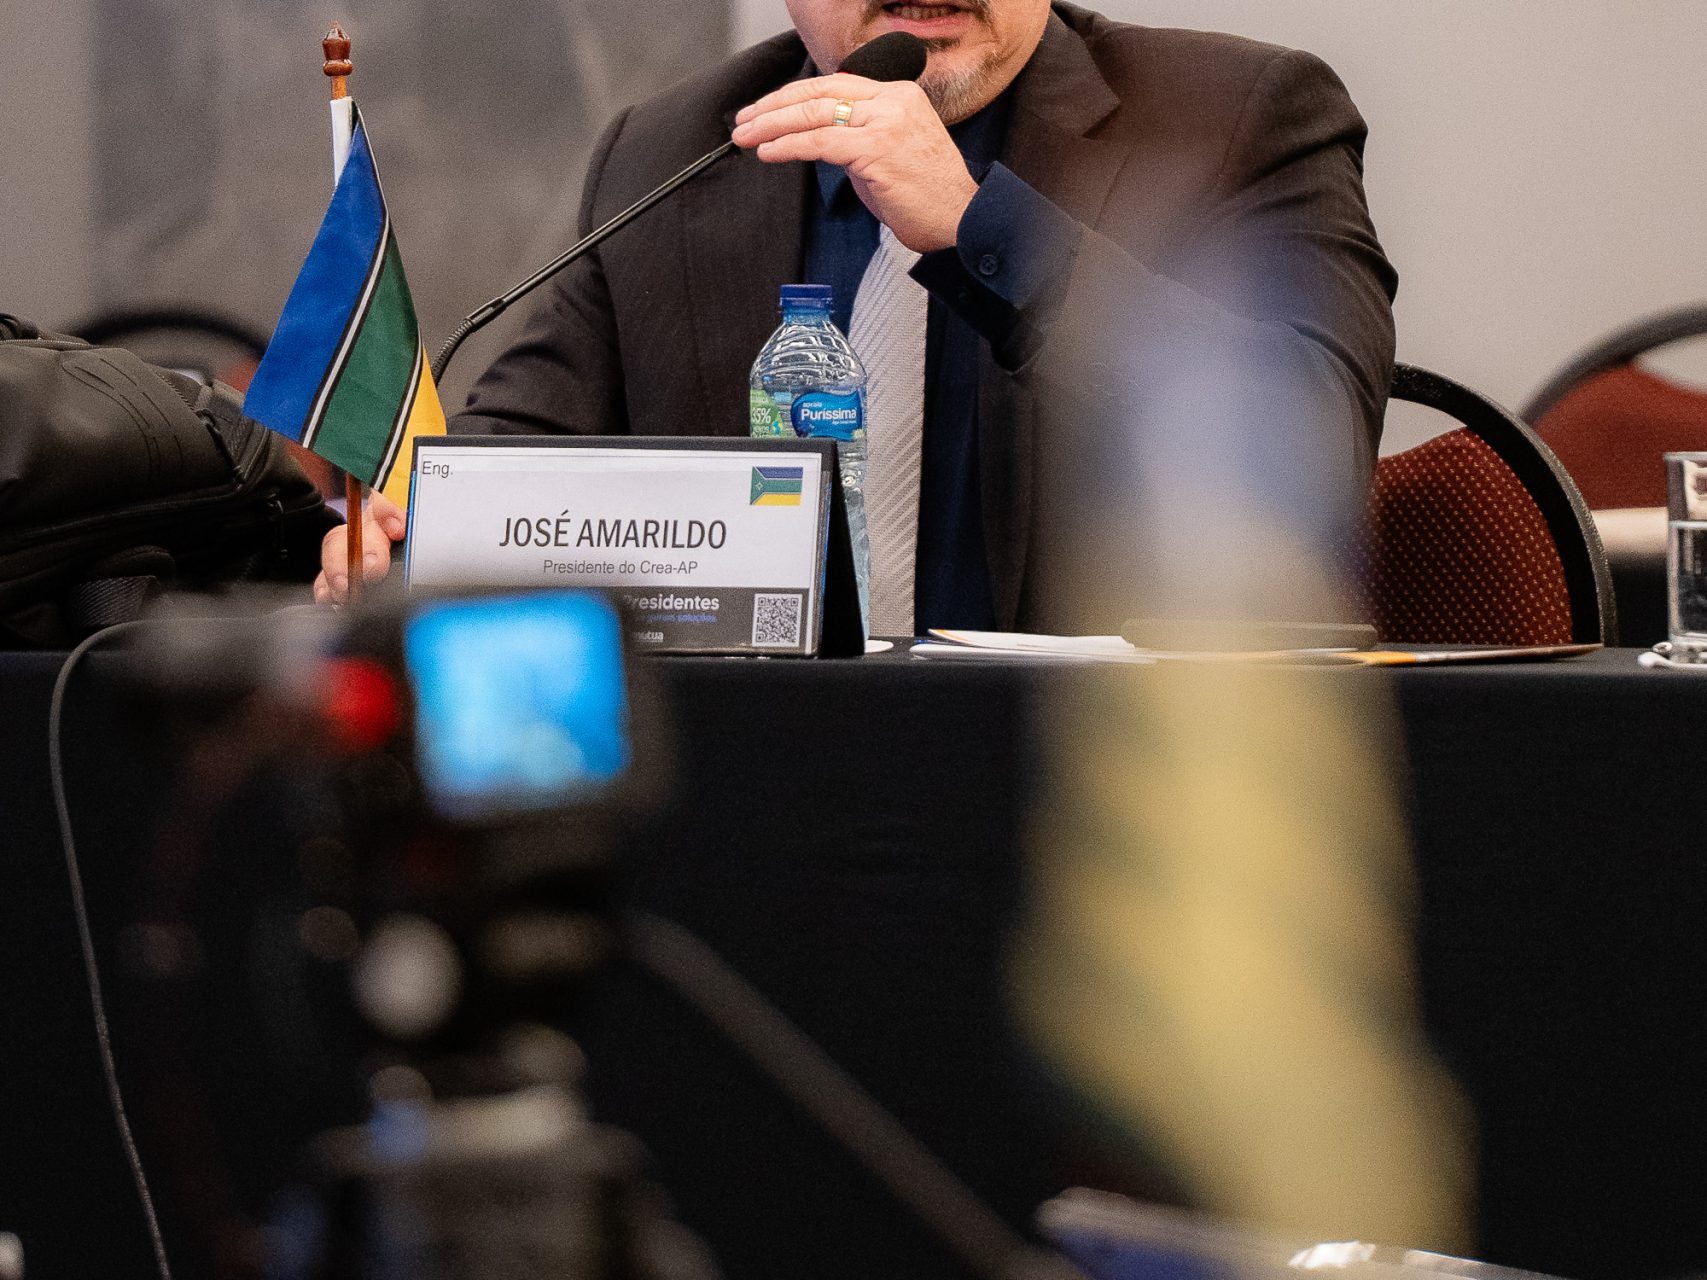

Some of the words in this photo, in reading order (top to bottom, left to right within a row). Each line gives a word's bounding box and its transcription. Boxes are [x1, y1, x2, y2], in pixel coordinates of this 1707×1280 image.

[422, 460, 453, 479] Eng.
[499, 508, 571, 548] JOSÉ
[576, 518, 728, 550] AMARILDO
[543, 559, 614, 574] Presidente
[619, 560, 635, 574] do
[640, 560, 698, 574] Crea-AP
